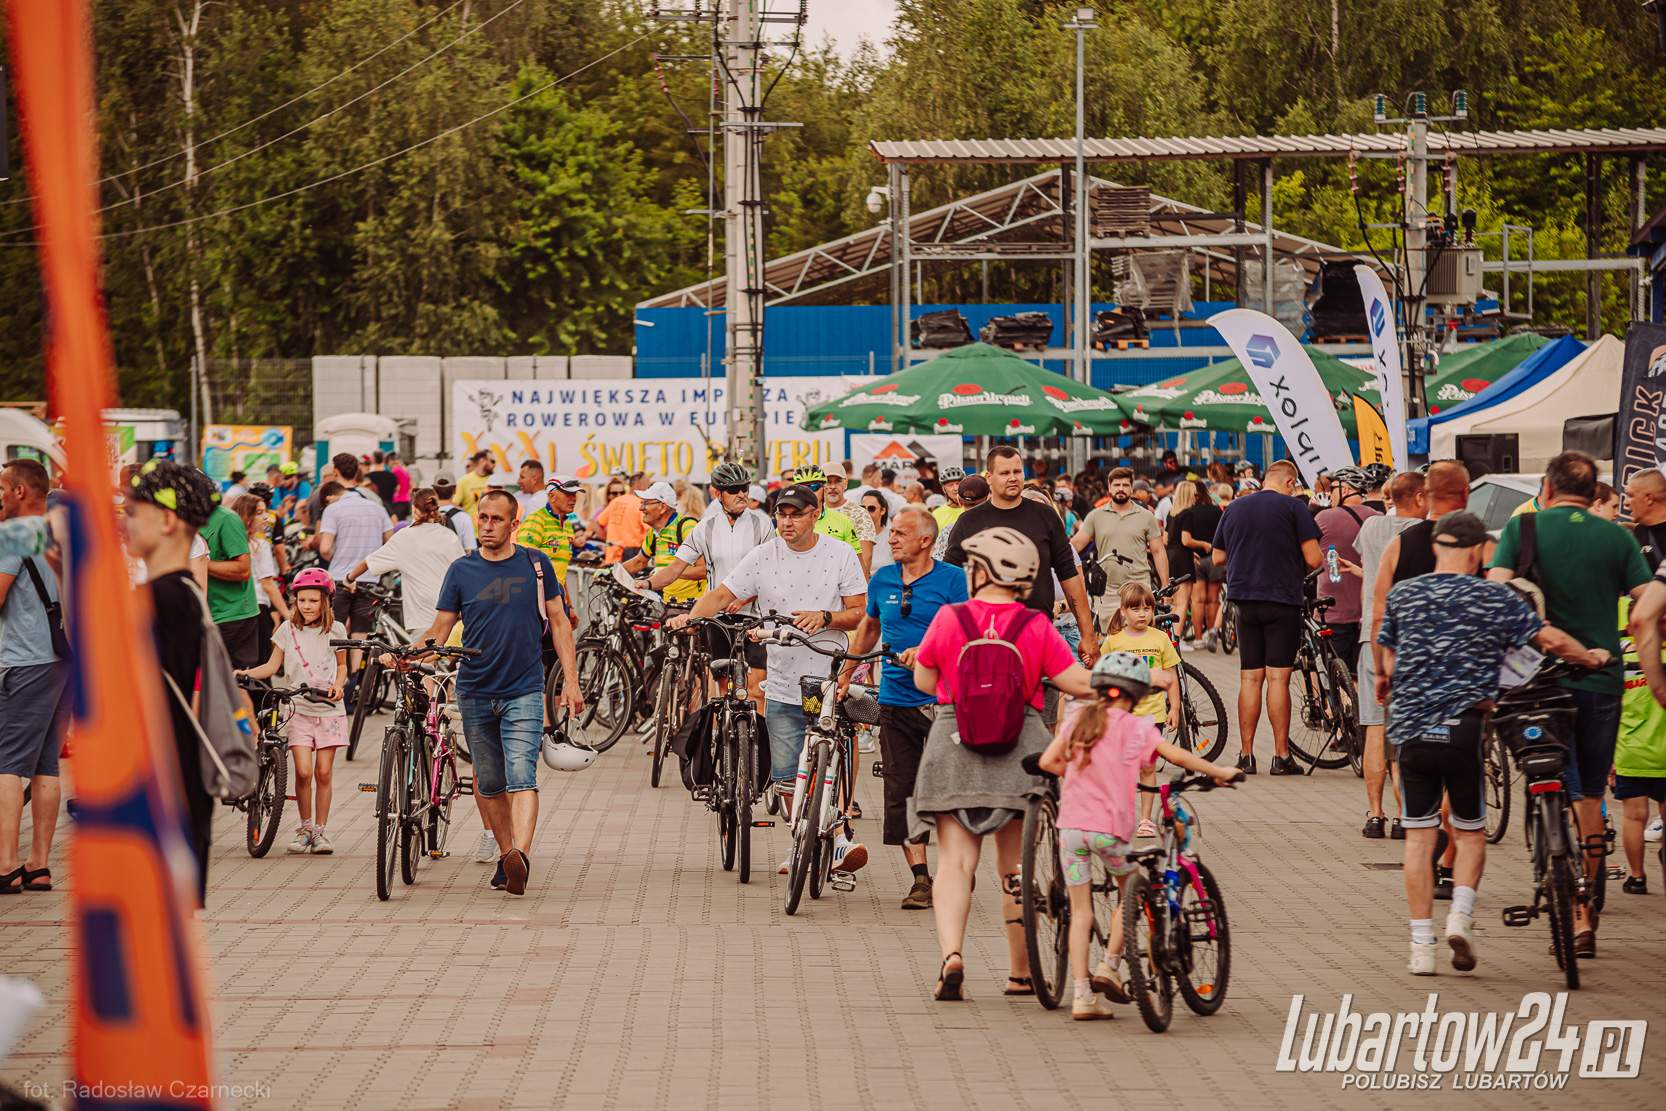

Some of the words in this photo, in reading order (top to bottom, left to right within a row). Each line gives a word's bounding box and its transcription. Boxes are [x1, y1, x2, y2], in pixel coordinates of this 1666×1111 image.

[512, 389, 667, 408] NAJWIĘKSZA
[682, 388, 788, 403] IMPZA
[507, 412, 645, 427] ROWEROWA
[659, 412, 675, 426] W
[691, 411, 795, 425] EUIE
[579, 434, 694, 478] ŚWIĘTO
